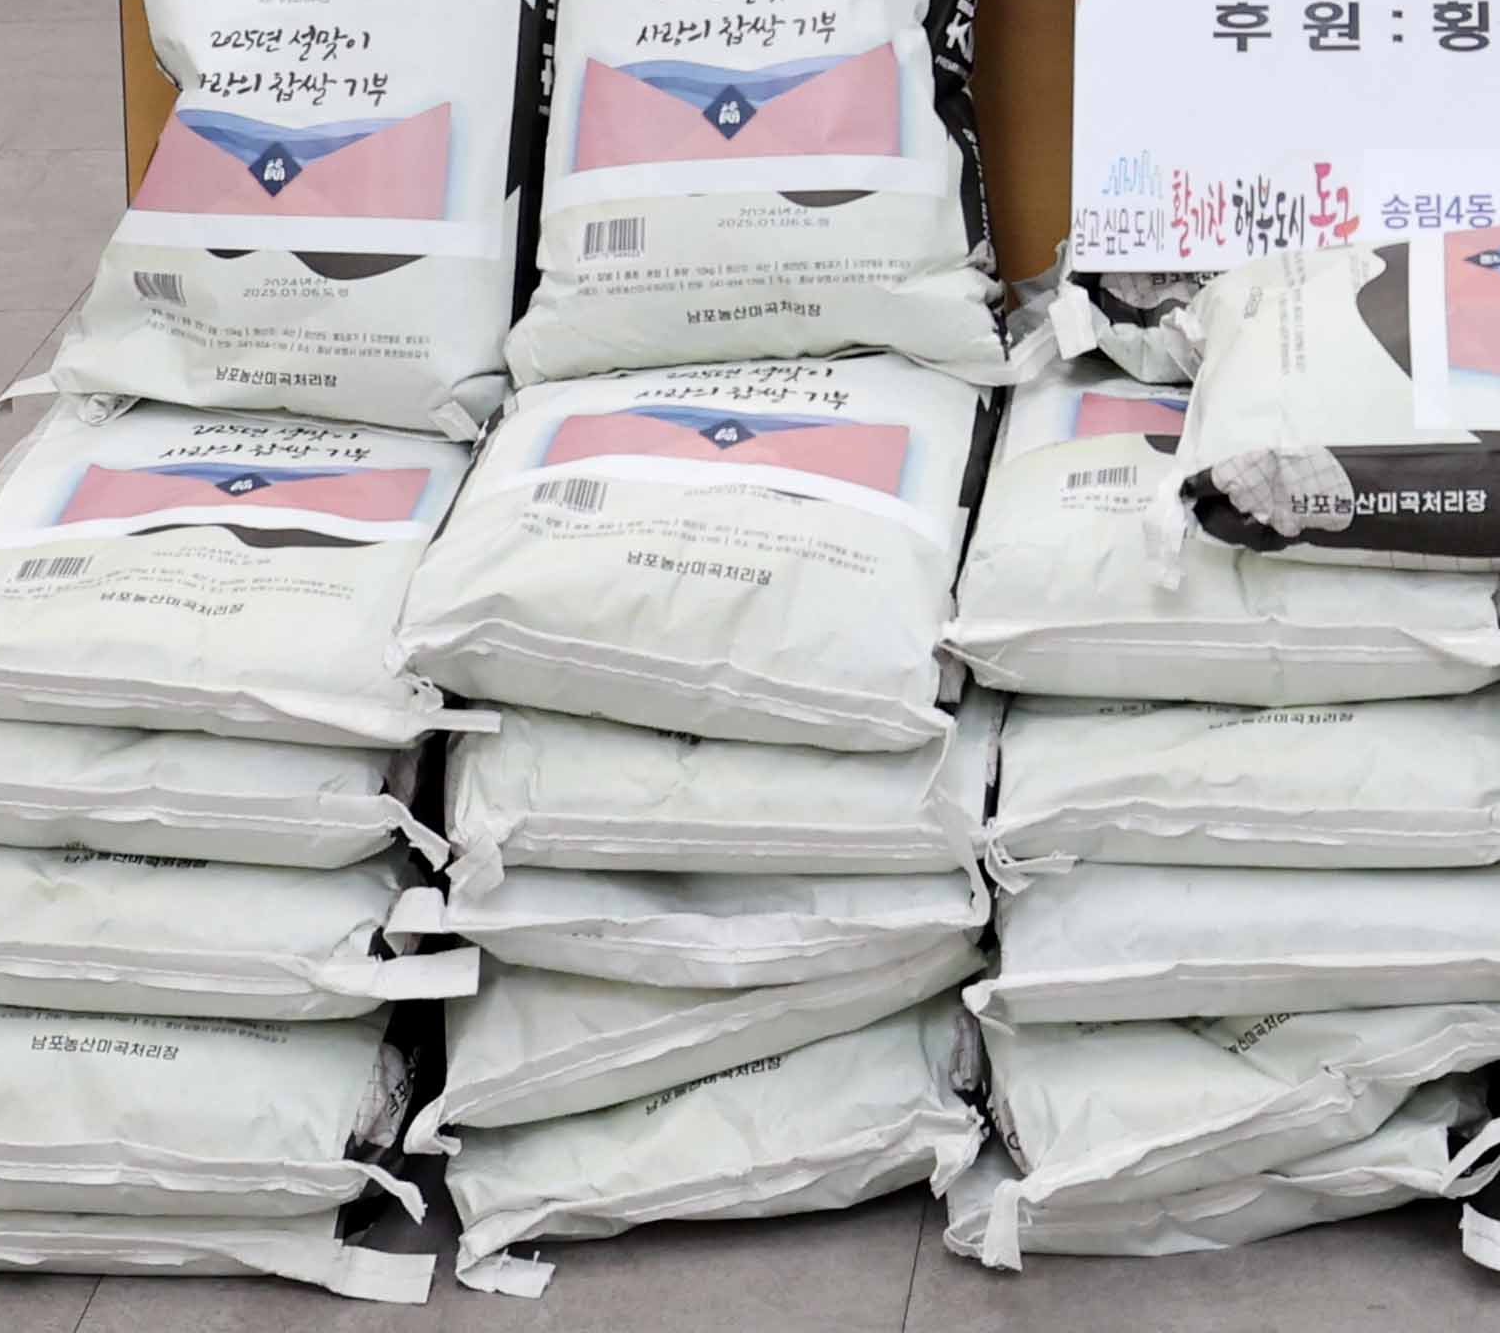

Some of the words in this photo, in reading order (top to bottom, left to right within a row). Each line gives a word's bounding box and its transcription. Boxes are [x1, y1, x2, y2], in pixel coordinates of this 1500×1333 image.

[211, 28, 283, 52] 2025년
[288, 24, 370, 61] 설맞이
[636, 18, 711, 46] 사랑의
[719, 14, 786, 48] 찹쌀
[795, 11, 837, 45] 기부
[268, 71, 337, 105] 찹쌀
[345, 72, 388, 106] 기부
[1103, 207, 1129, 254] 싶은
[1134, 210, 1165, 252] 도시!
[1170, 169, 1227, 258] 활기찬
[1232, 174, 1305, 256] 행복도시
[1380, 192, 1496, 230] 송림4동
[686, 300, 821, 325] 남포농산미곡처리장
[215, 366, 338, 387] 남포농산미곡처리장
[1291, 488, 1488, 516] 남포농산미곡처리장
[627, 549, 773, 586] 남포농산미곡처리장
[100, 591, 245, 615] 남포농산미곡처리장
[30, 1034, 180, 1061] 남포농산미곡처리장
